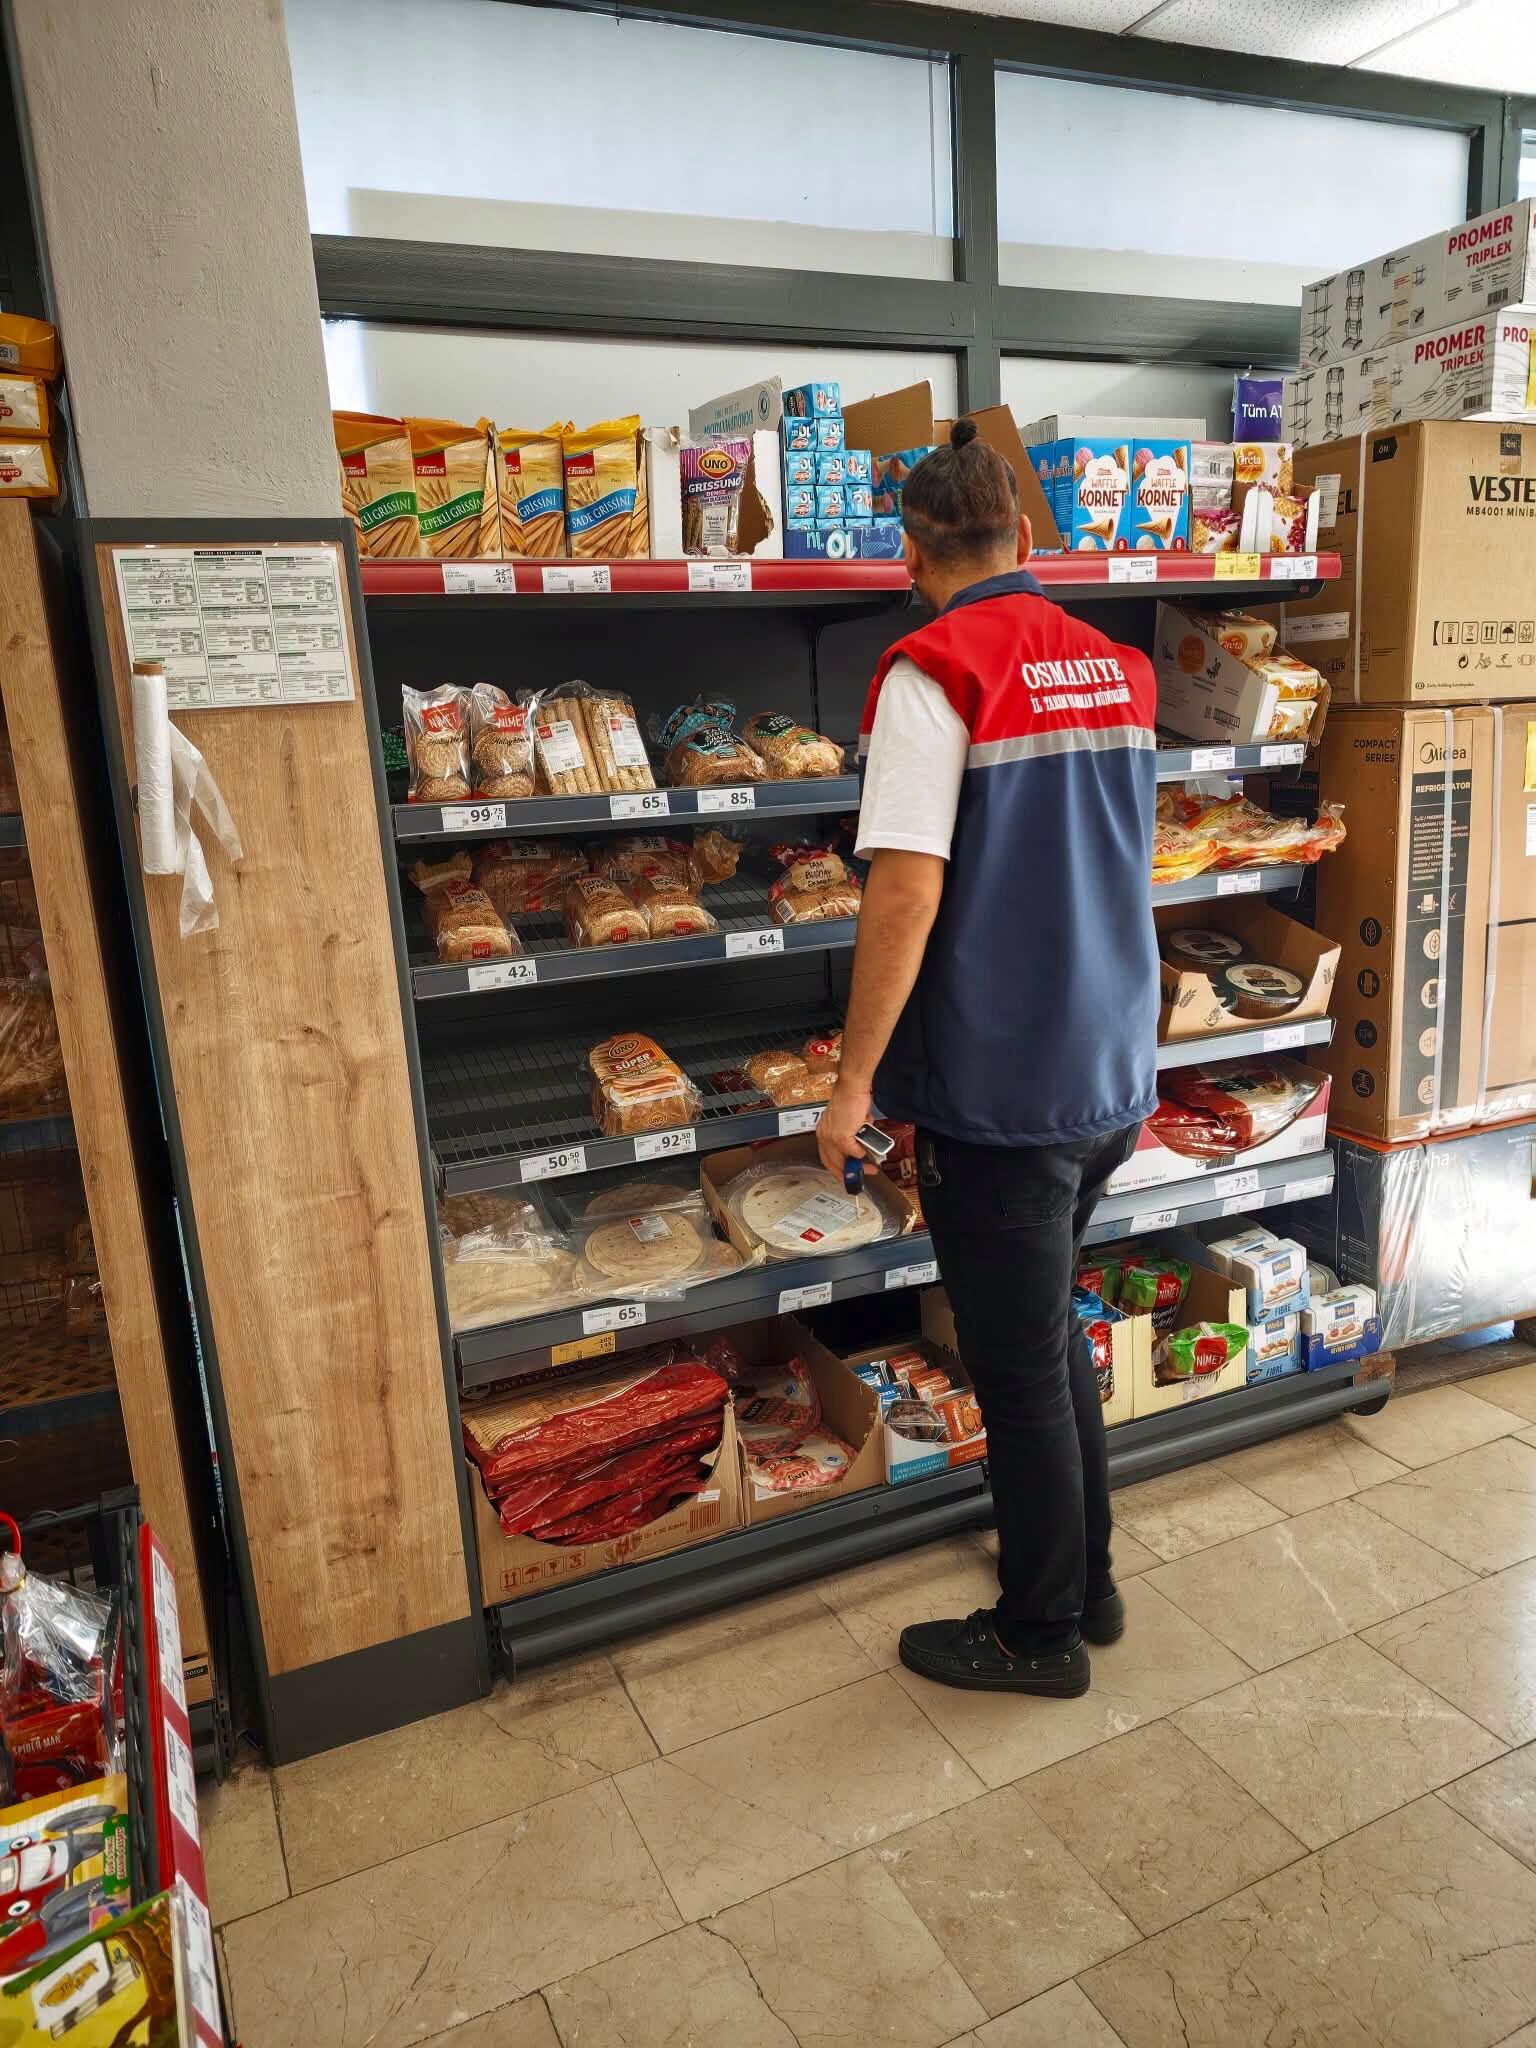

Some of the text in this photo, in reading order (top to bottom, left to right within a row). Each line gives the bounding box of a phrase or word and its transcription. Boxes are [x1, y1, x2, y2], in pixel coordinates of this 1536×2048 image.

[1447, 214, 1513, 256] PROMER
[1466, 240, 1512, 268] TRIPLEX
[1414, 324, 1486, 365] PROMER
[1441, 349, 1485, 374] TRIPLEX
[1242, 403, 1268, 419] Tüm
[704, 459, 729, 469] UNO
[1078, 488, 1128, 508] KORNET
[1136, 489, 1185, 508] KORNET
[1466, 506, 1504, 517] MB4001
[570, 511, 593, 529] SADE
[1021, 652, 1126, 690] OSMANİYE
[1353, 739, 1397, 749] COMPACT
[1365, 752, 1397, 763] SERIES
[642, 795, 661, 809] 65
[730, 792, 749, 805] 85
[759, 934, 776, 946] 64
[508, 965, 529, 979] 42
[614, 1042, 635, 1055] UNO
[615, 1053, 651, 1072] SÜPER
[1158, 1213, 1172, 1224] 40
[618, 1306, 637, 1321] 65
